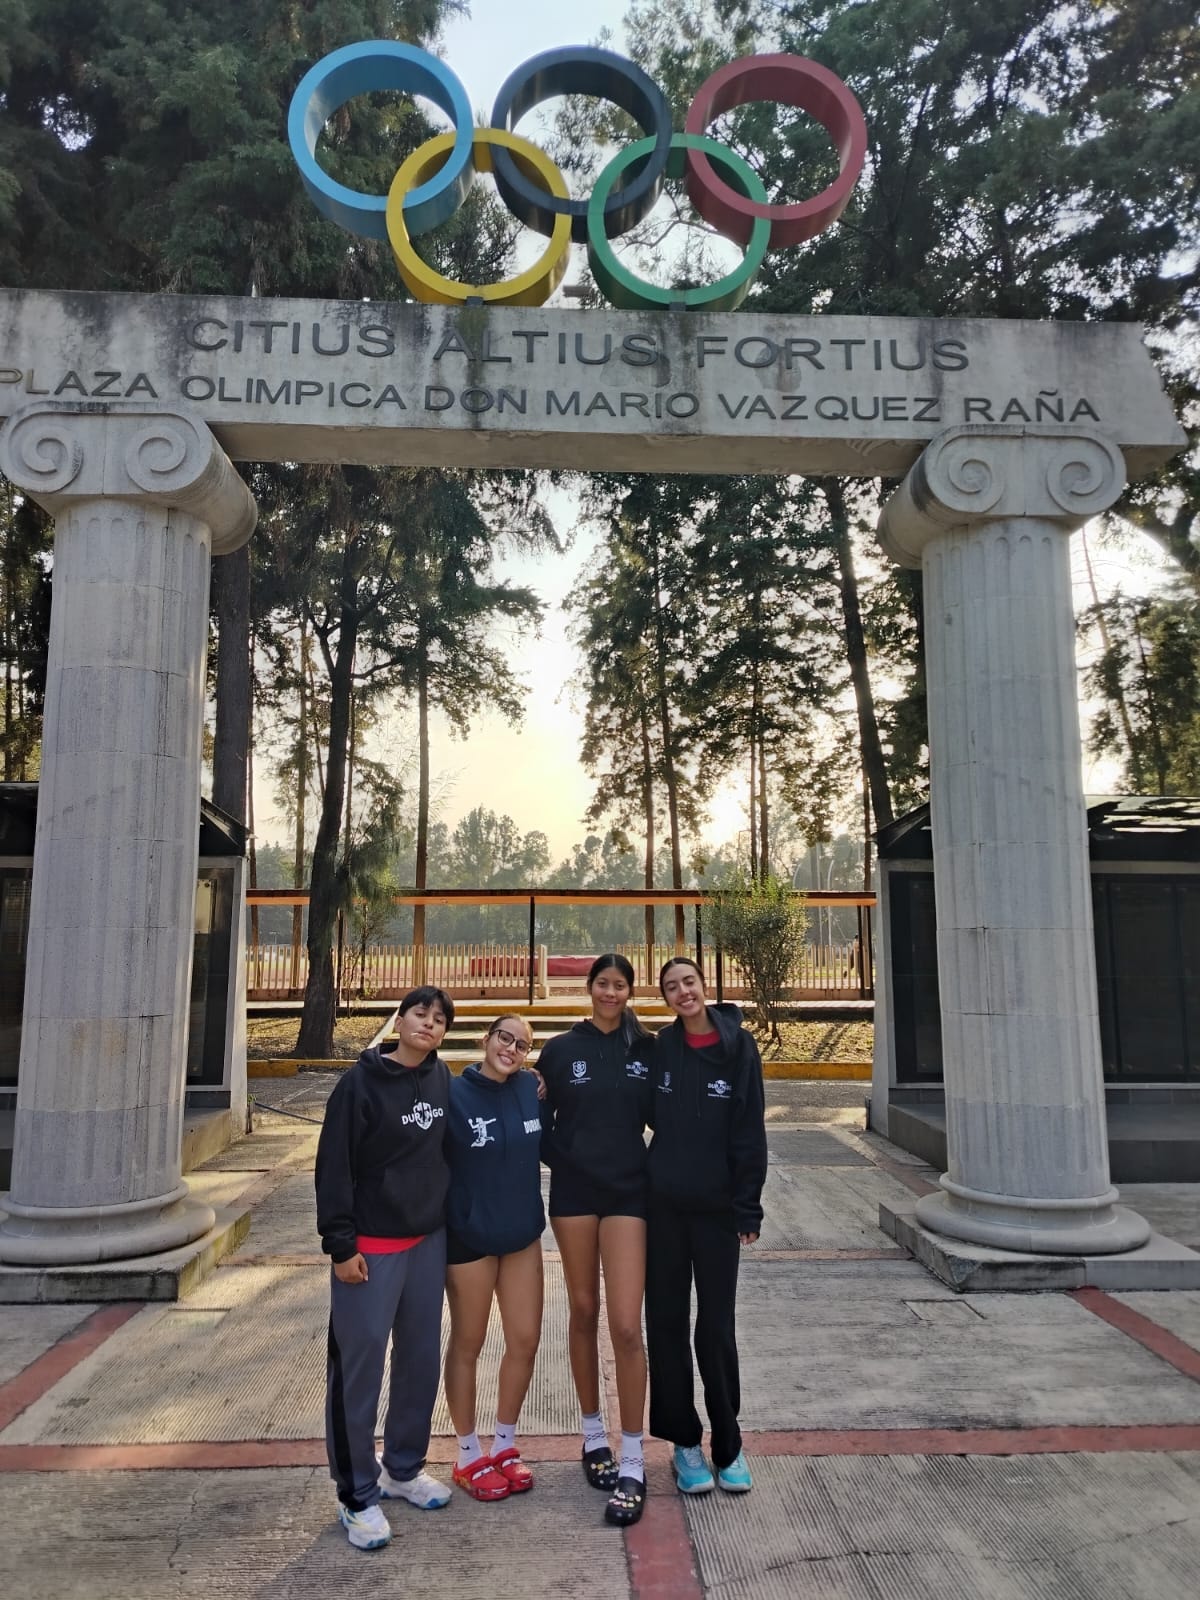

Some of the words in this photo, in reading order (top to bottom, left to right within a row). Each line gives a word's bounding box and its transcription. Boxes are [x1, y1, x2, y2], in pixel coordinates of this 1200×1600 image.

[184, 318, 396, 358] CITIUS
[433, 329, 658, 366] ALTIUS
[697, 336, 969, 371] FORTIUS
[181, 375, 407, 410] OLIMPICA
[424, 385, 527, 413] DON
[546, 390, 699, 418] MARIO
[718, 393, 941, 422] VAZQUEZ
[964, 388, 1100, 422] RAÑA
[401, 1107, 444, 1125] DURNGO
